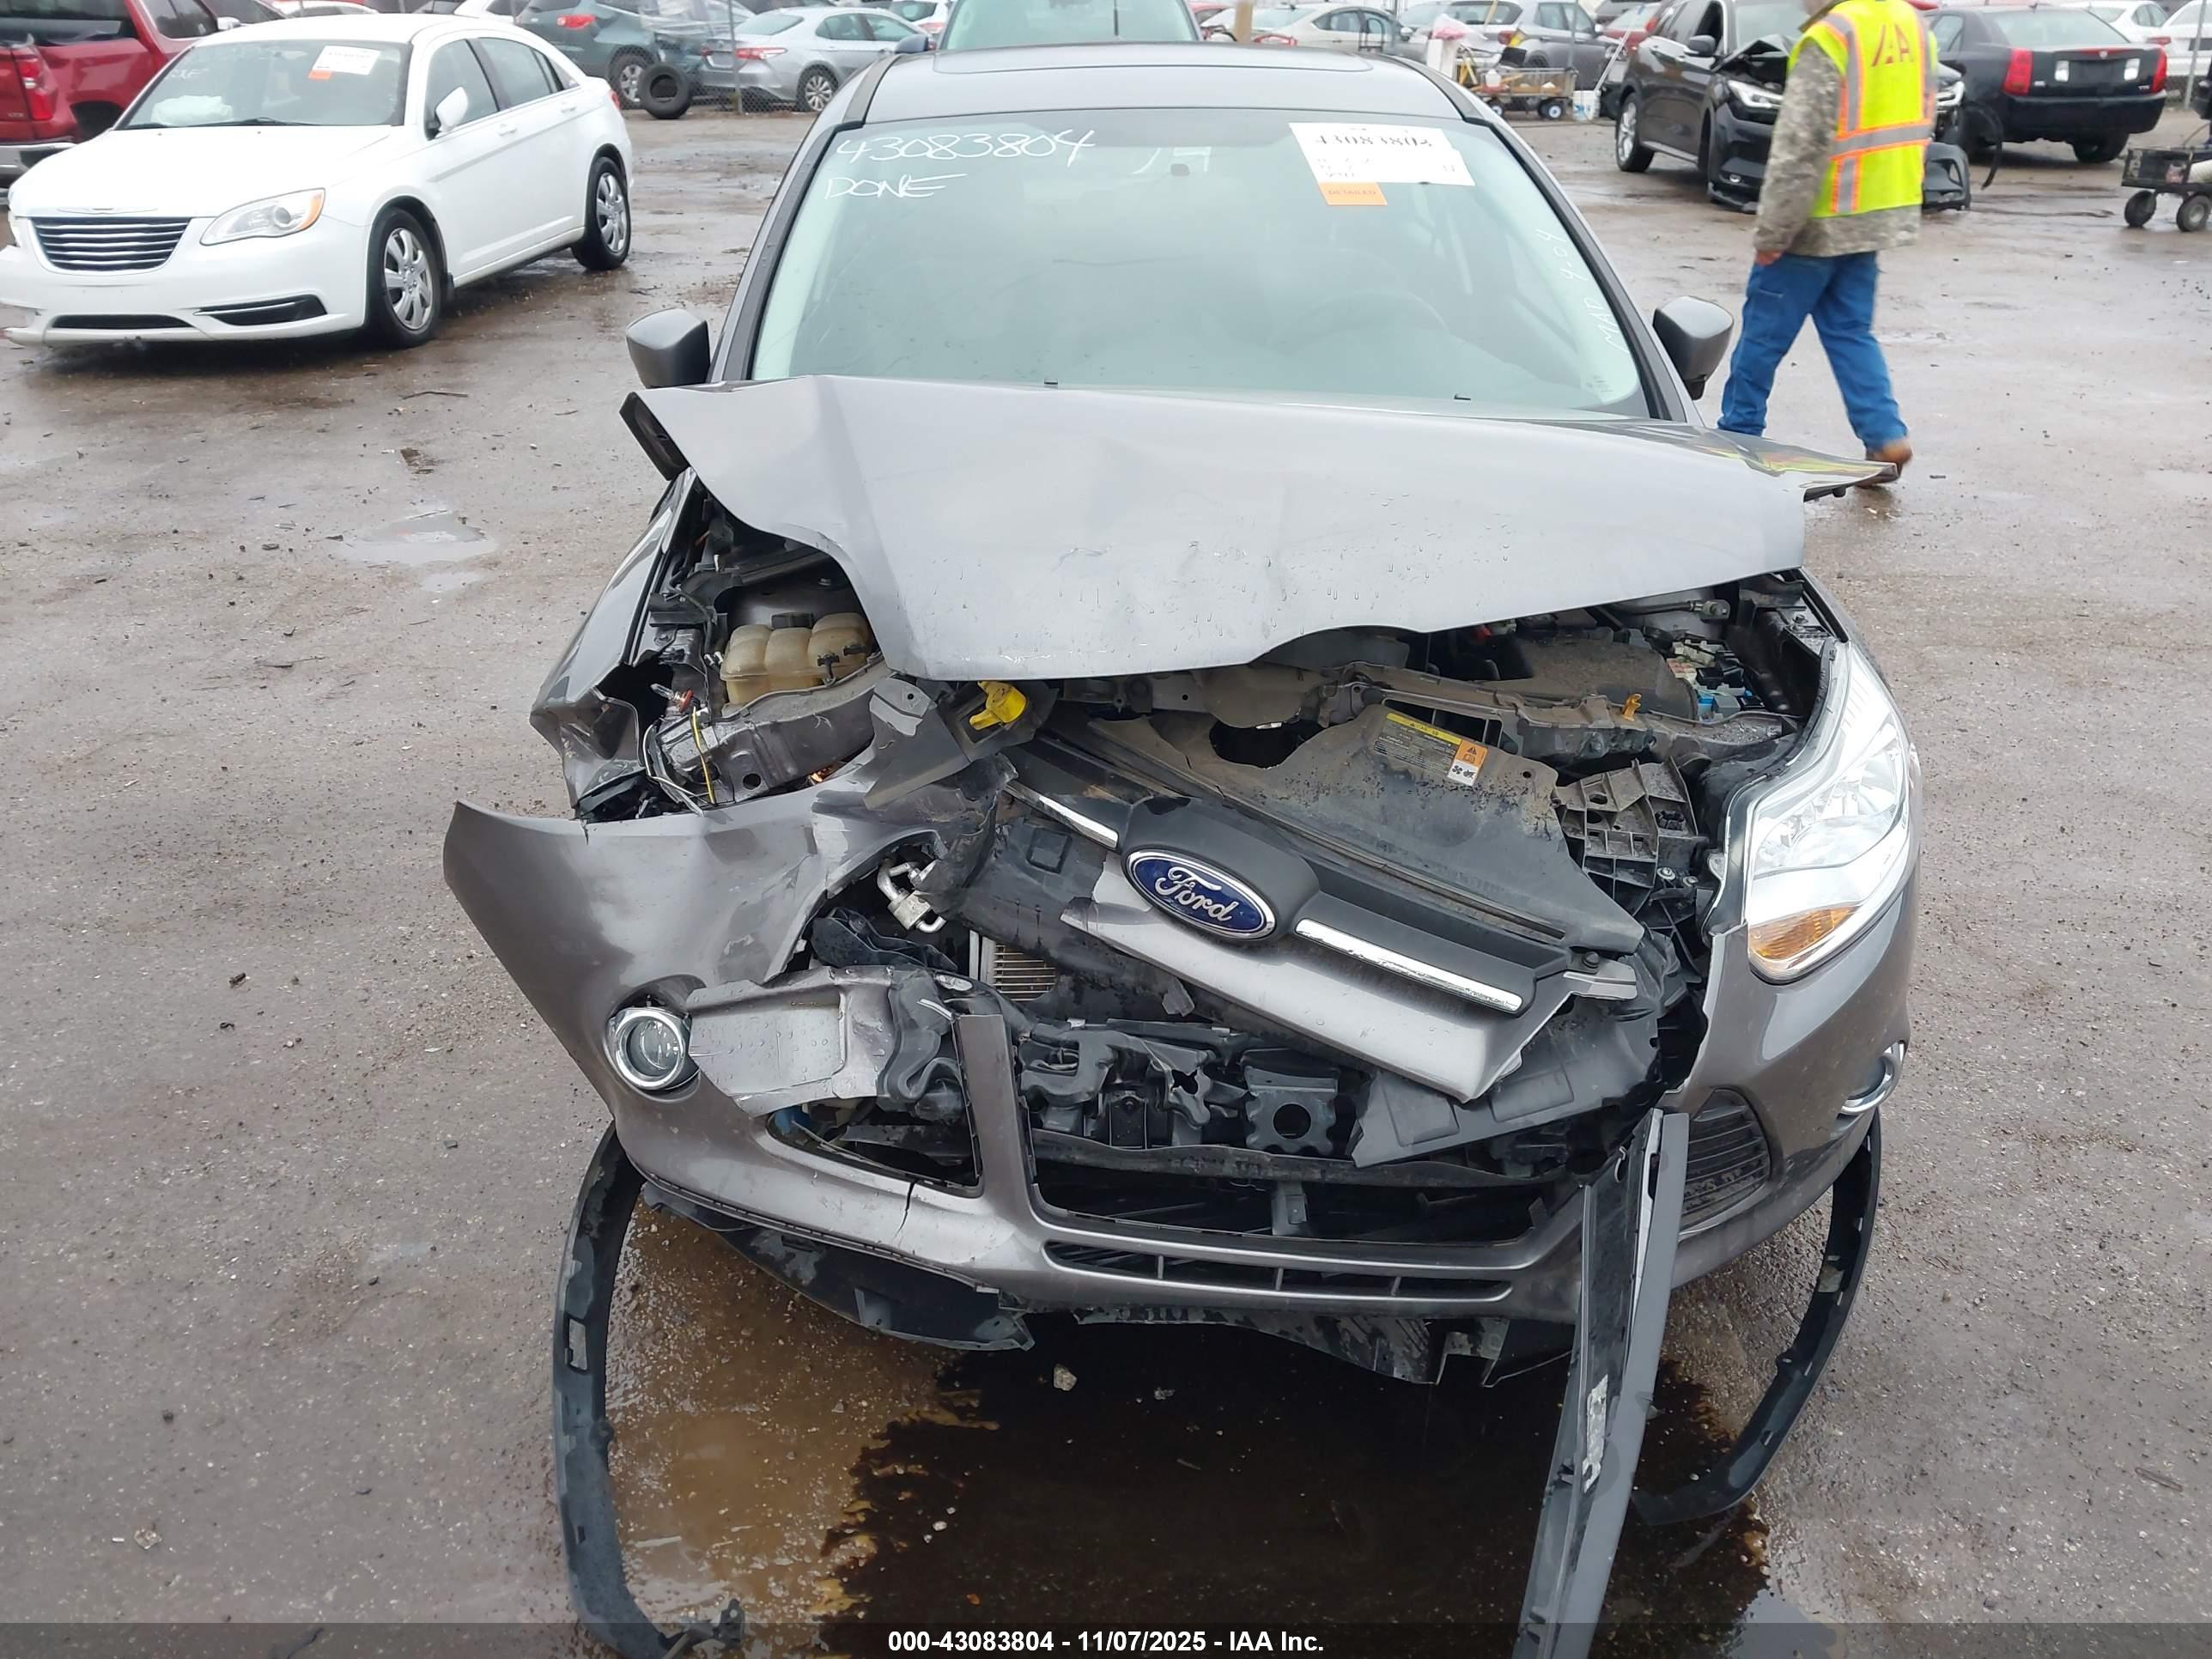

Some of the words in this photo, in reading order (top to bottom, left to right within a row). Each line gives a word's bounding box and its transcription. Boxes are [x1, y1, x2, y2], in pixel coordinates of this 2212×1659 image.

[836, 128, 1097, 167] 43083804
[823, 172, 969, 200] DONE
[1154, 866, 1240, 922] Ford
